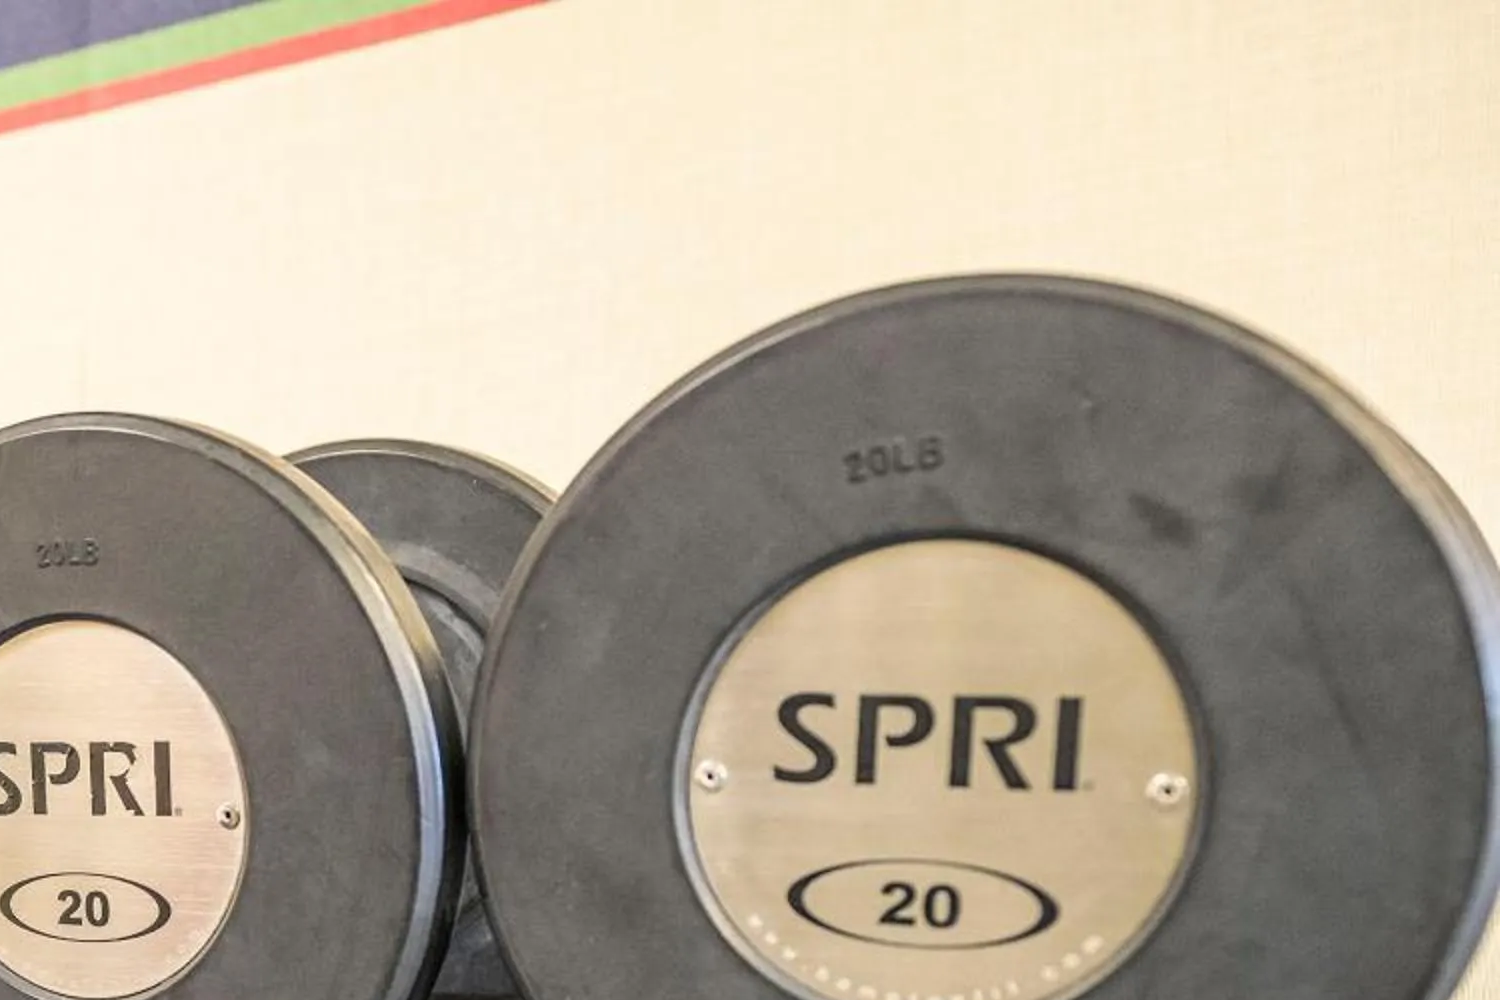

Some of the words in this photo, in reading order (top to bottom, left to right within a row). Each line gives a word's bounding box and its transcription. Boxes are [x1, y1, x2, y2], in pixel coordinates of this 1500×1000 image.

[842, 436, 945, 485] 20LB
[36, 538, 100, 569] 20LB
[772, 692, 1085, 791] SPRI
[57, 889, 111, 928] 20
[878, 881, 961, 928] 20
